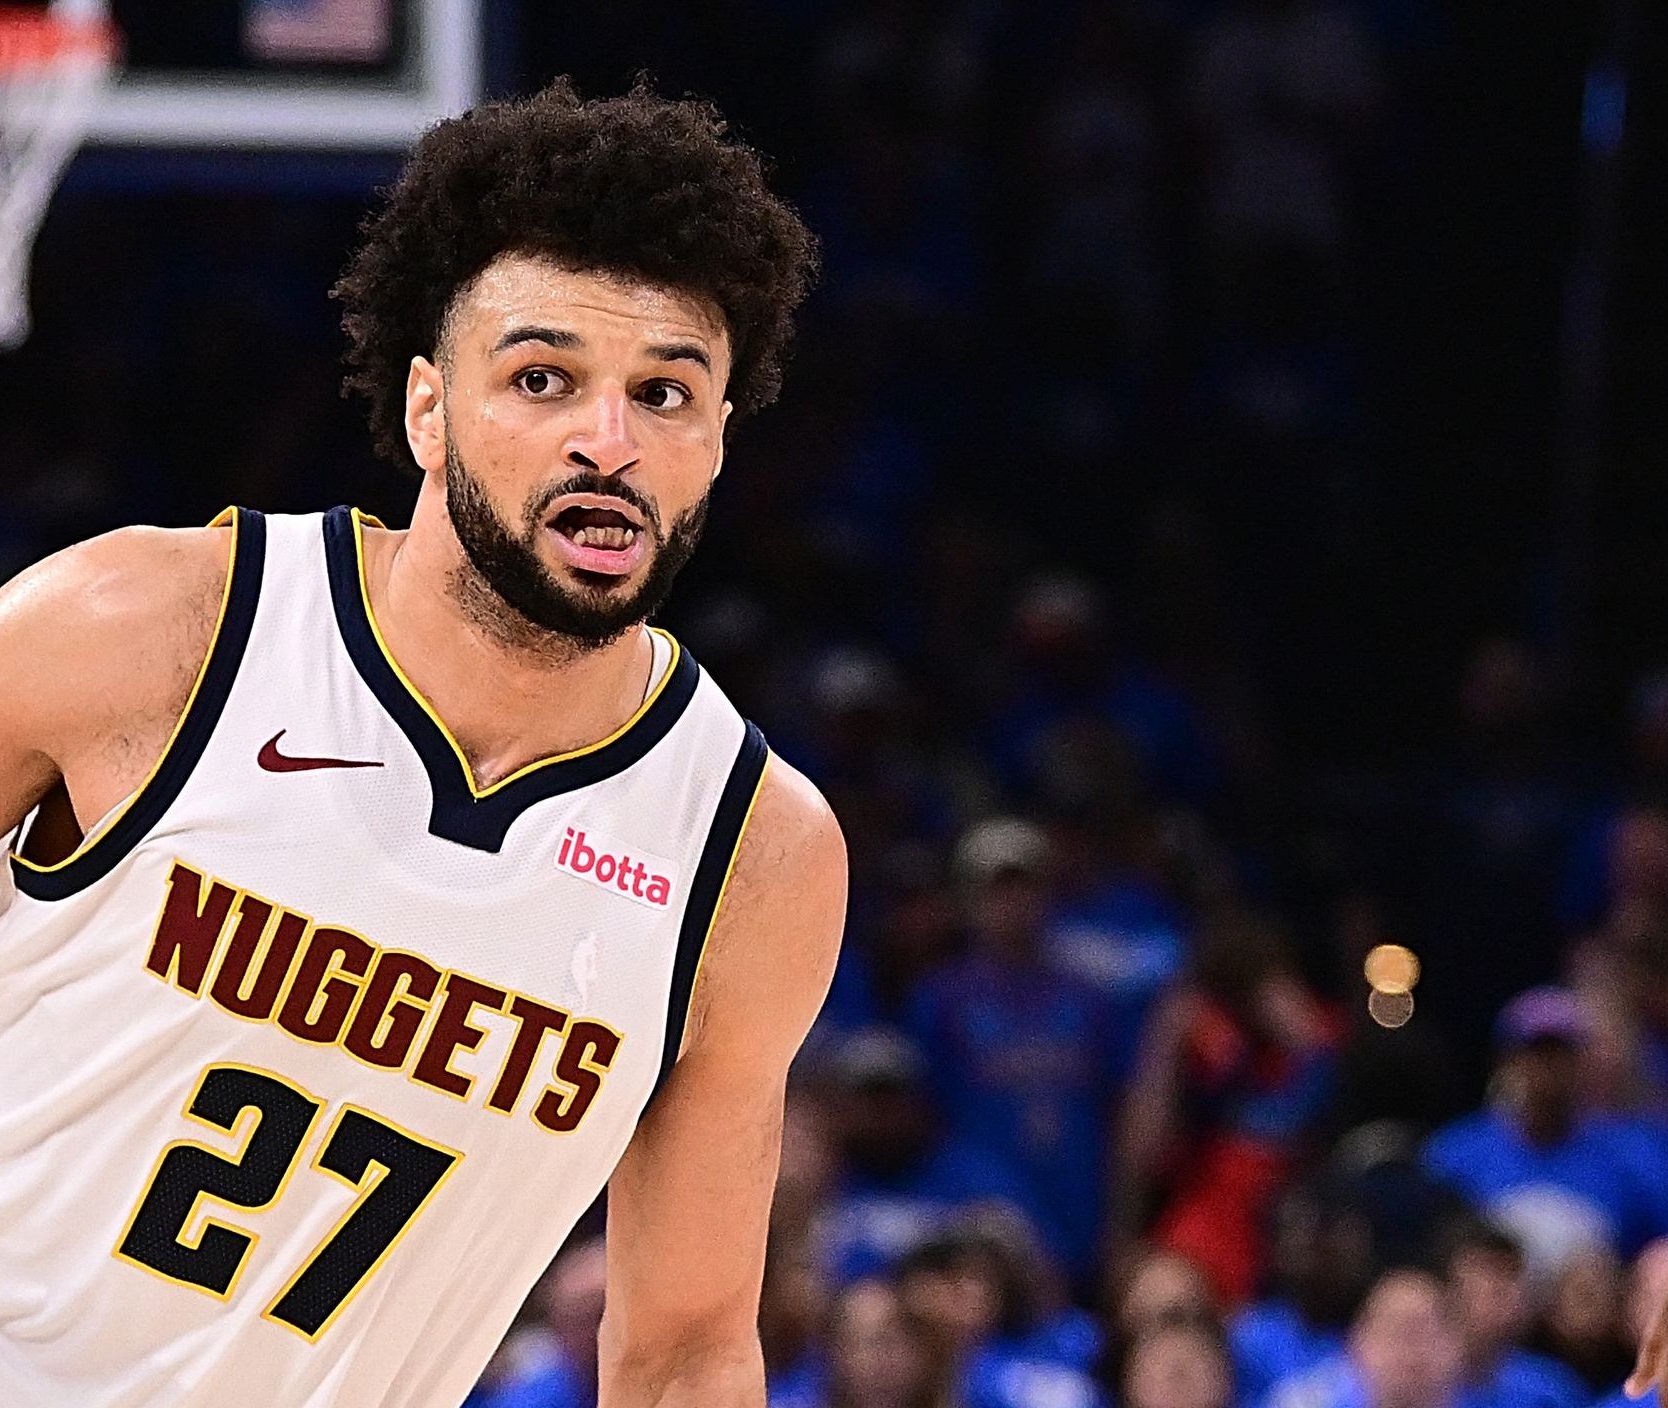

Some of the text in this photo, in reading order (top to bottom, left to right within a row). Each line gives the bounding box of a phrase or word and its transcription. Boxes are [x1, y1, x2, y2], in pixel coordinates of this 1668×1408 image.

[142, 856, 624, 1136] NUGGETS
[557, 827, 671, 906] ibotta
[111, 1060, 465, 1344] 27
